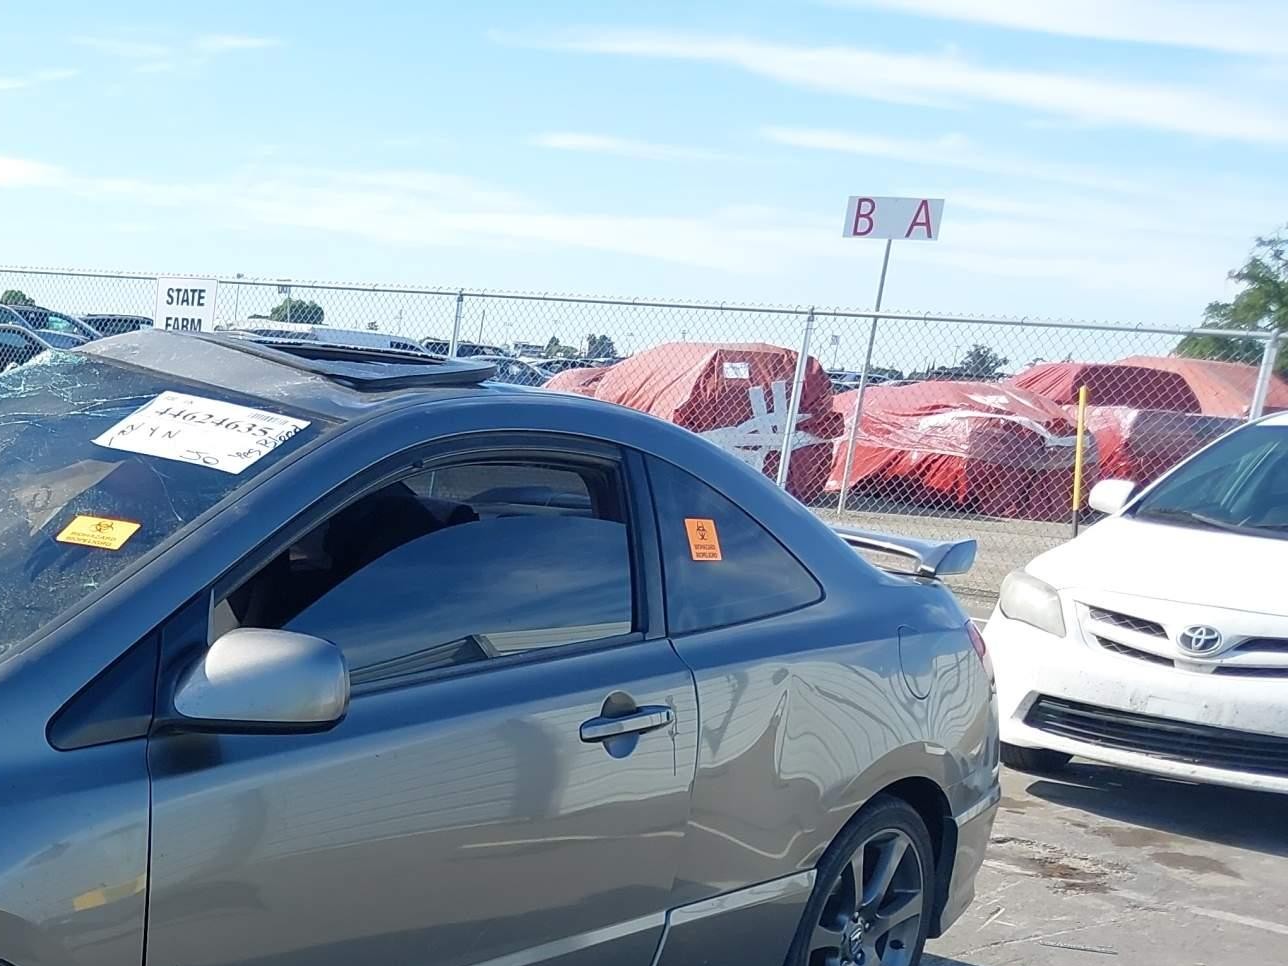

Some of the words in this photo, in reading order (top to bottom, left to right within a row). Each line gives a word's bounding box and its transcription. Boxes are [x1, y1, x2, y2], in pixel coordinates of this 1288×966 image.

[853, 198, 876, 236] B
[905, 199, 932, 239] A
[166, 287, 206, 307] STATE
[165, 316, 202, 332] FARM
[154, 407, 275, 437] 44624635
